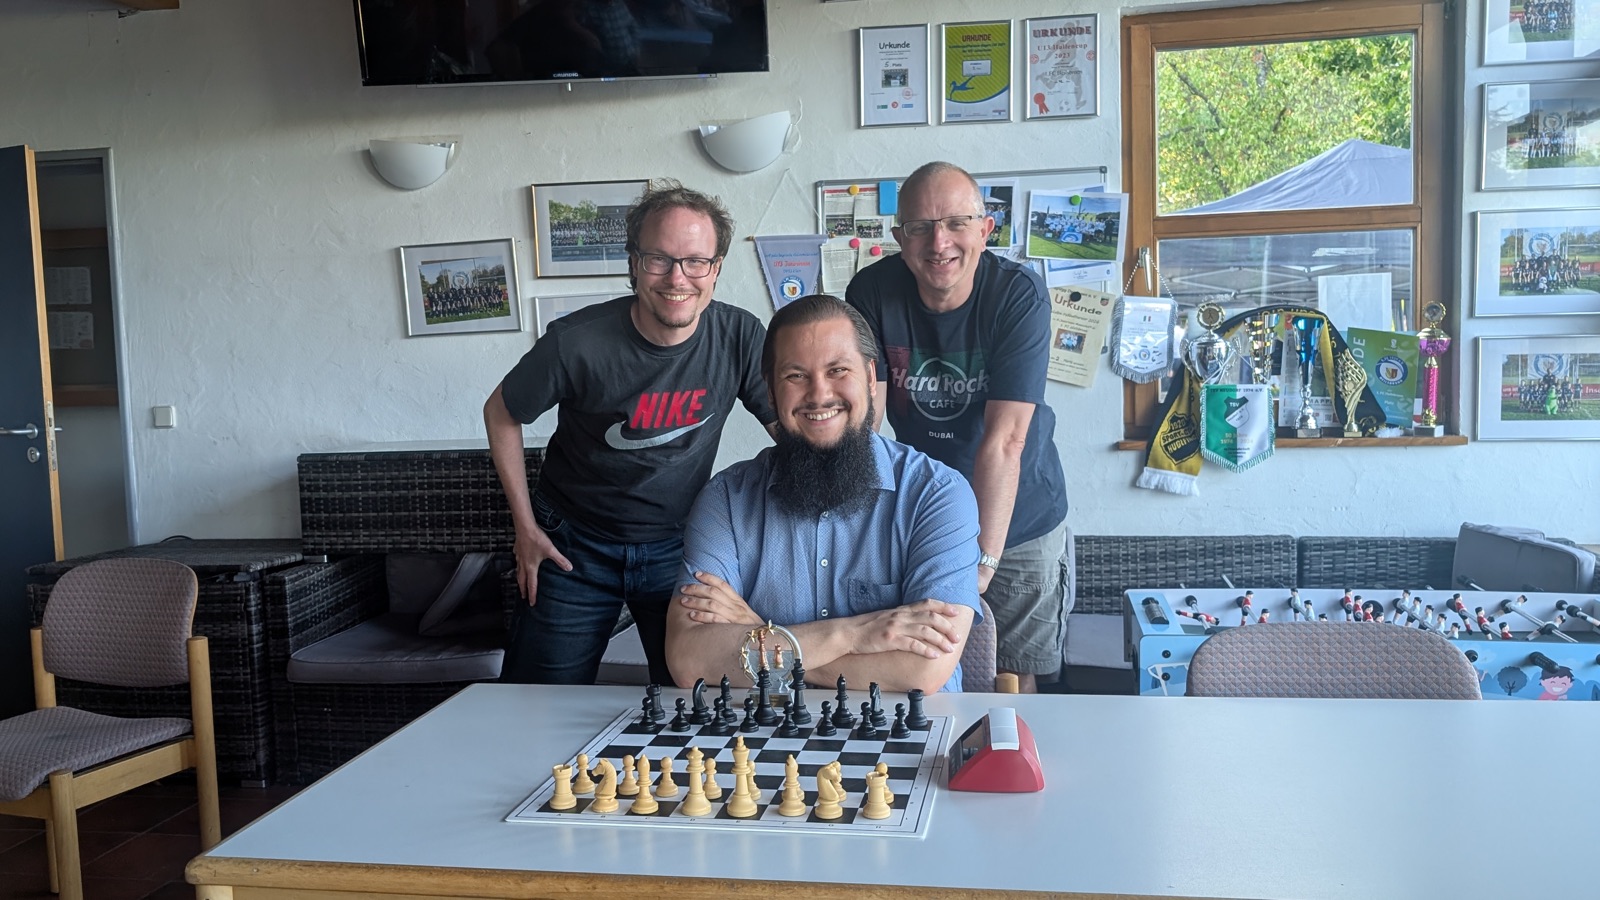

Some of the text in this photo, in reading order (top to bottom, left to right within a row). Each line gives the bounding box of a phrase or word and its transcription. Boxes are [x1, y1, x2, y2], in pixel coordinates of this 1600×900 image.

[1032, 26, 1092, 38] URKUNDE
[962, 34, 992, 42] URKUNDE
[879, 41, 910, 50] Urkunde
[1054, 293, 1102, 316] Urkunde
[891, 368, 990, 398] Hard Rock
[630, 388, 707, 430] NIKE
[929, 399, 955, 409] CAFE
[928, 431, 954, 439] DUBAI
